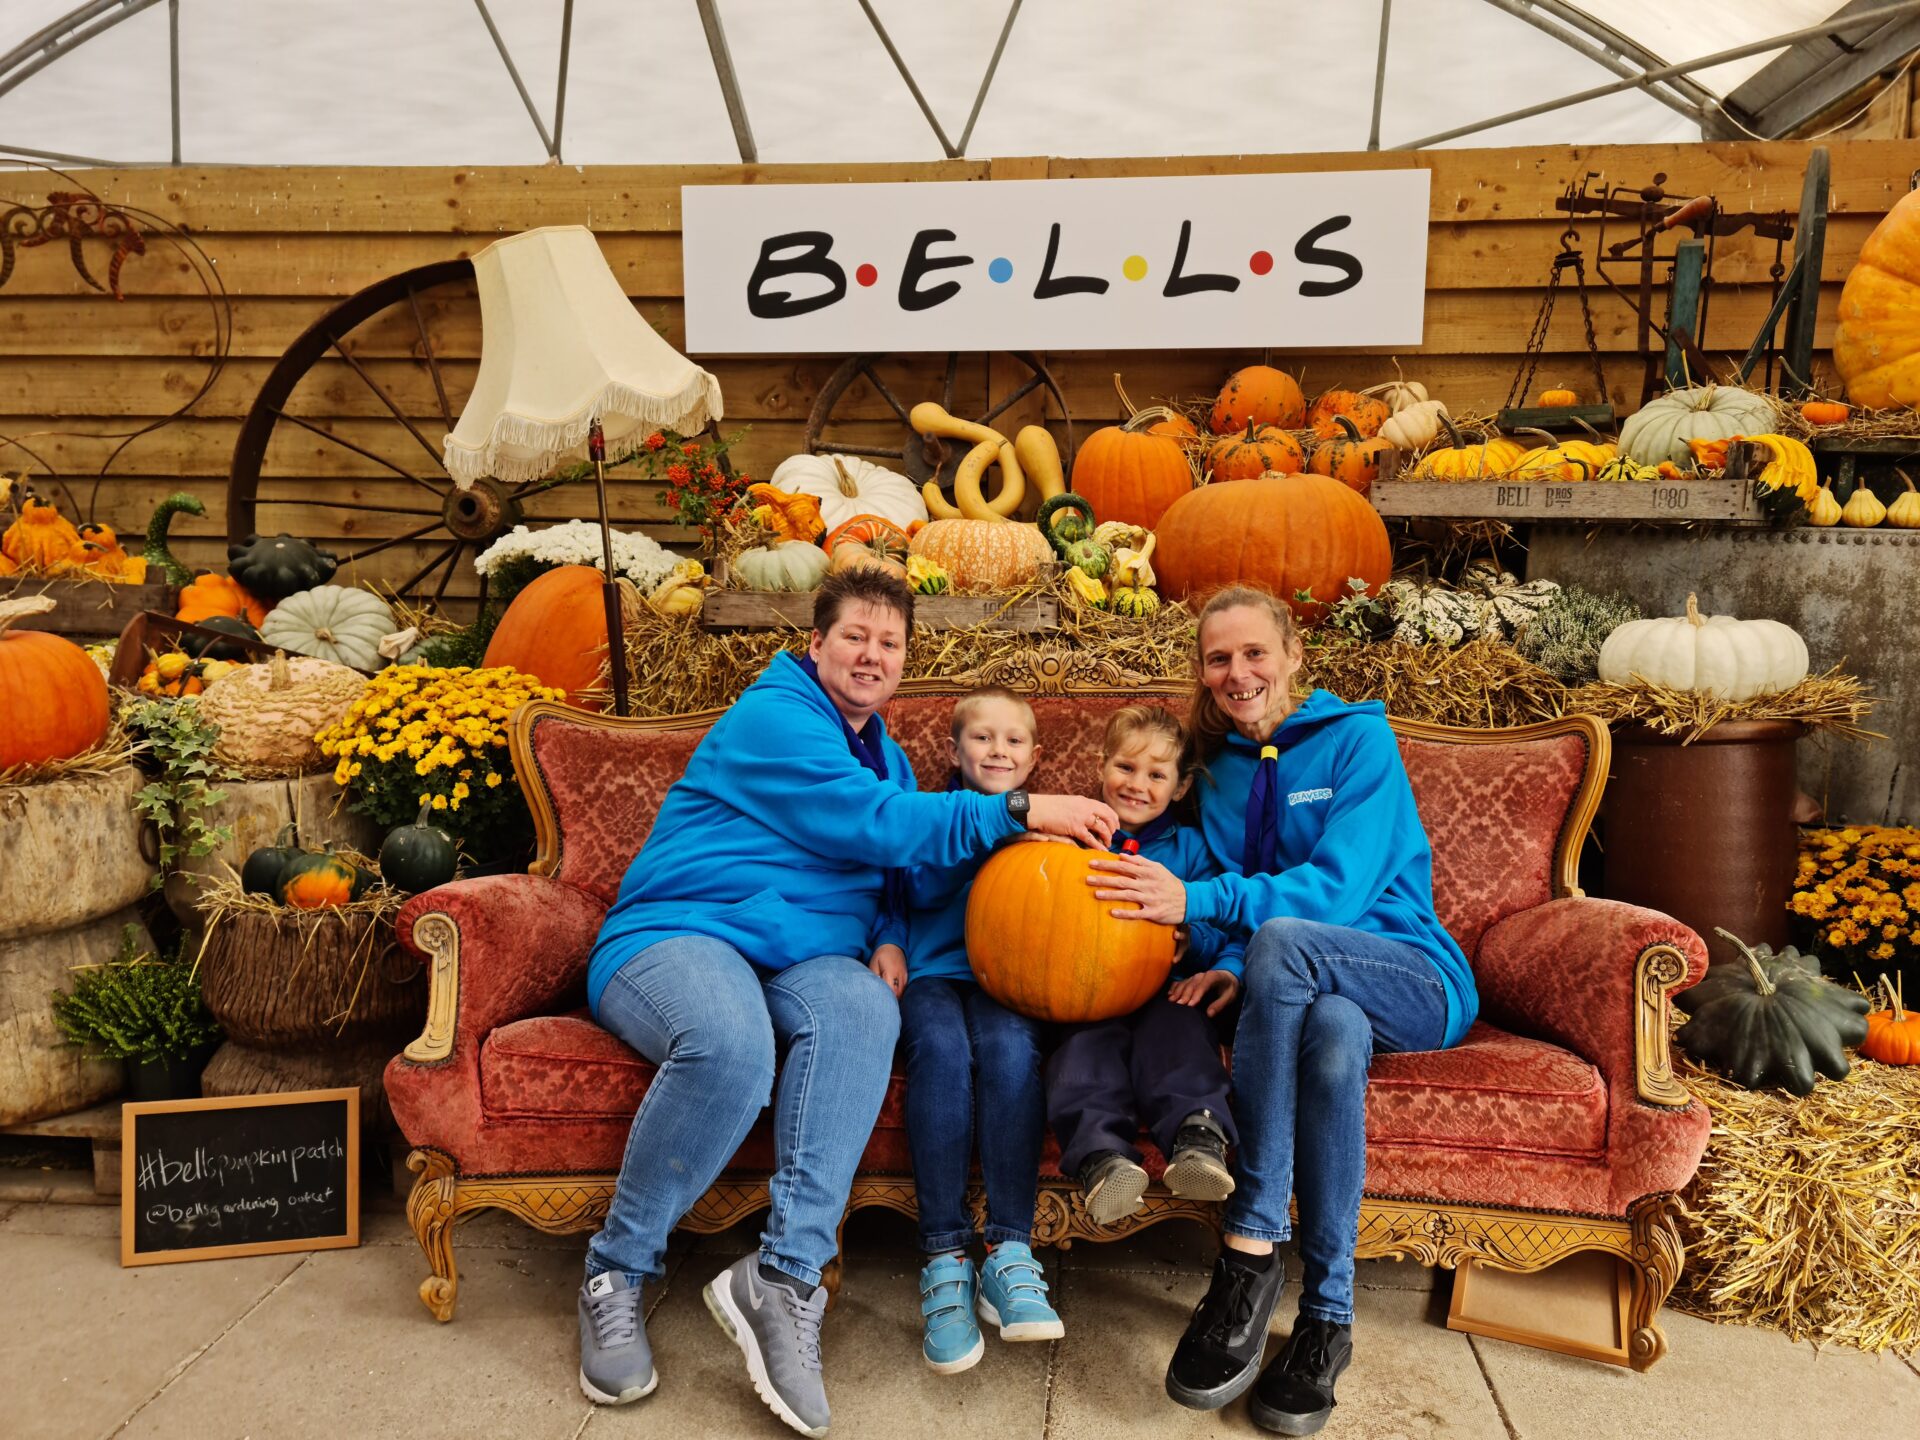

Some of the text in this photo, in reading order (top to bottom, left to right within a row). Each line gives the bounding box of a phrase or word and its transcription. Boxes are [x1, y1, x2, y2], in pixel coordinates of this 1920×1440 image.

[1497, 486, 1530, 506] BELL
[1651, 487, 1689, 509] 1980
[1288, 788, 1333, 806] BEAVERS
